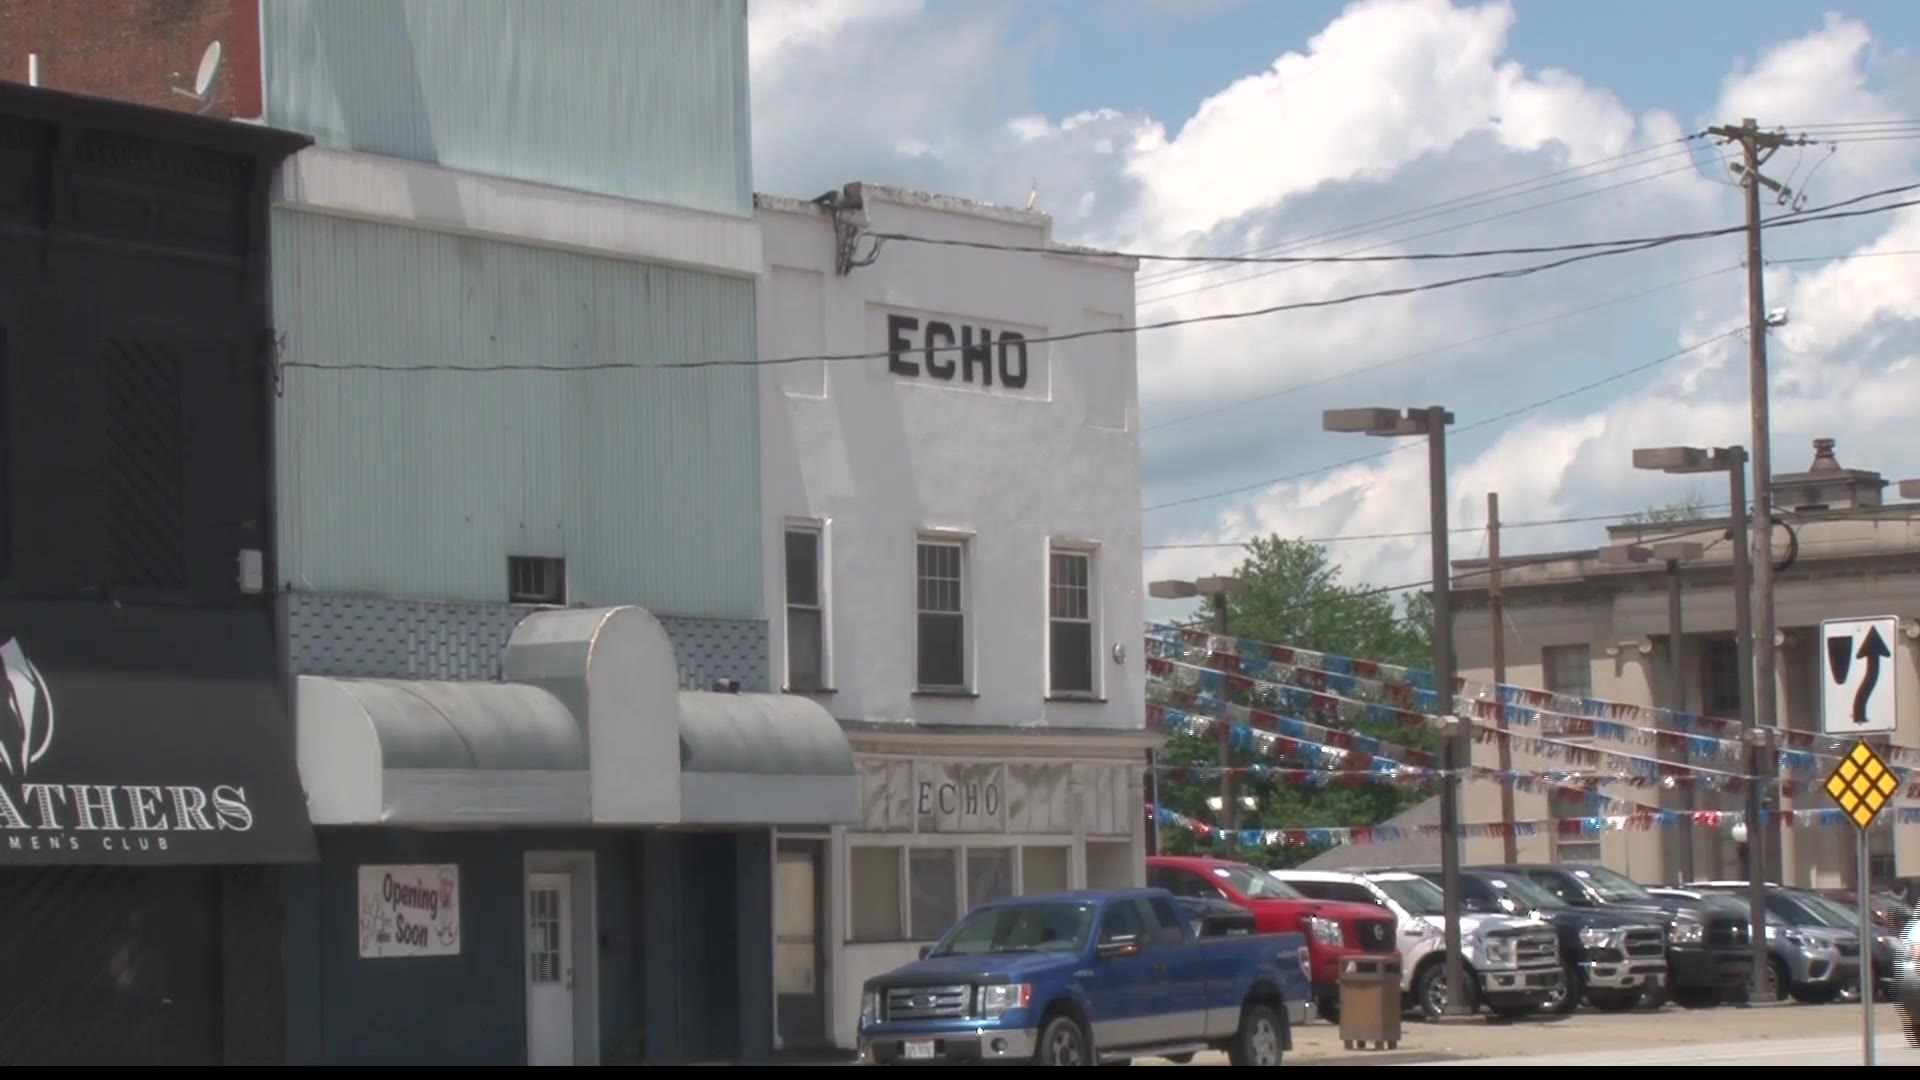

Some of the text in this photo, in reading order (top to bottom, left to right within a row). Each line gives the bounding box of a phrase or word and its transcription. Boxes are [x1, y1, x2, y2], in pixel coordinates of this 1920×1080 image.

[887, 313, 1028, 389] ECHO
[917, 781, 999, 817] ECHO
[103, 836, 168, 850] CLUB
[383, 872, 438, 921] Opening
[395, 912, 428, 949] Soon
